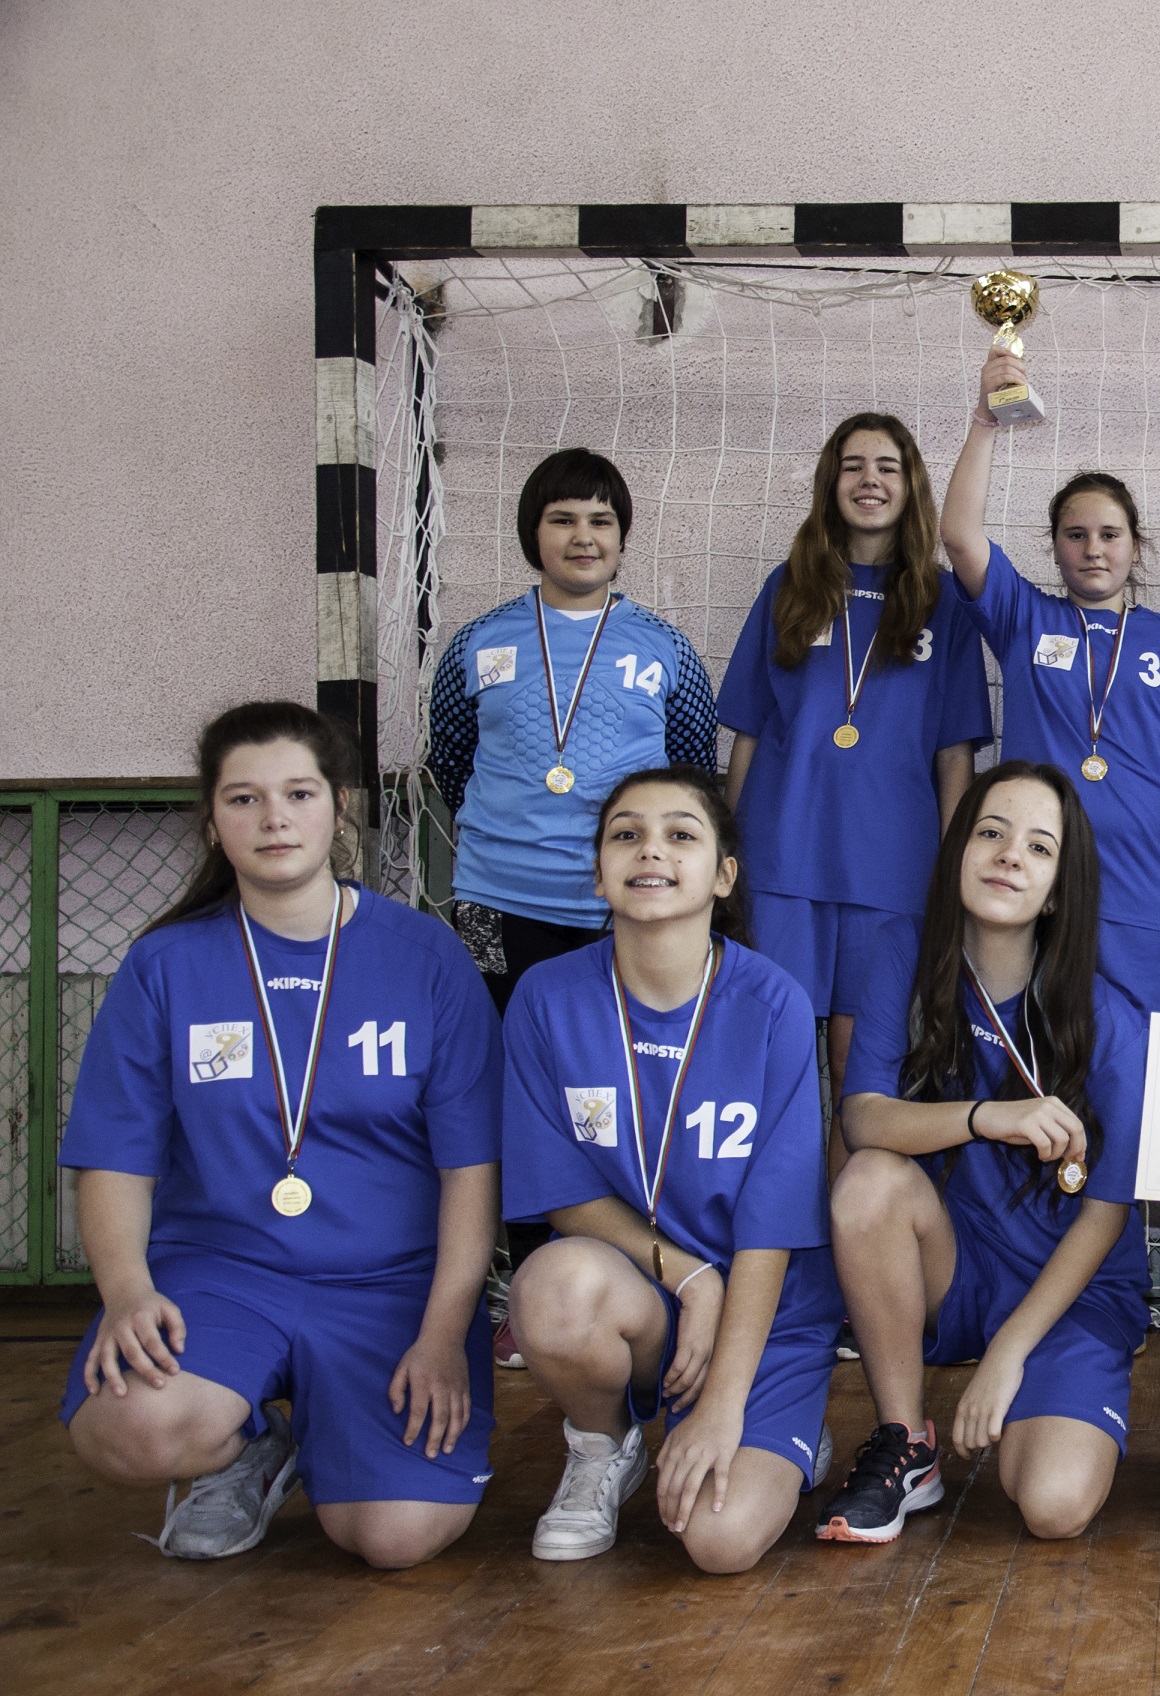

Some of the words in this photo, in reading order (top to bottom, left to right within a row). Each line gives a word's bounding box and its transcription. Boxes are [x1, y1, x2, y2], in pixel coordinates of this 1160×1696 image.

[615, 653, 663, 698] 14
[204, 1023, 250, 1040] УСПЕХ
[348, 1020, 406, 1076] 11
[574, 1088, 613, 1104] УСПЕХ
[685, 1101, 758, 1159] 12
